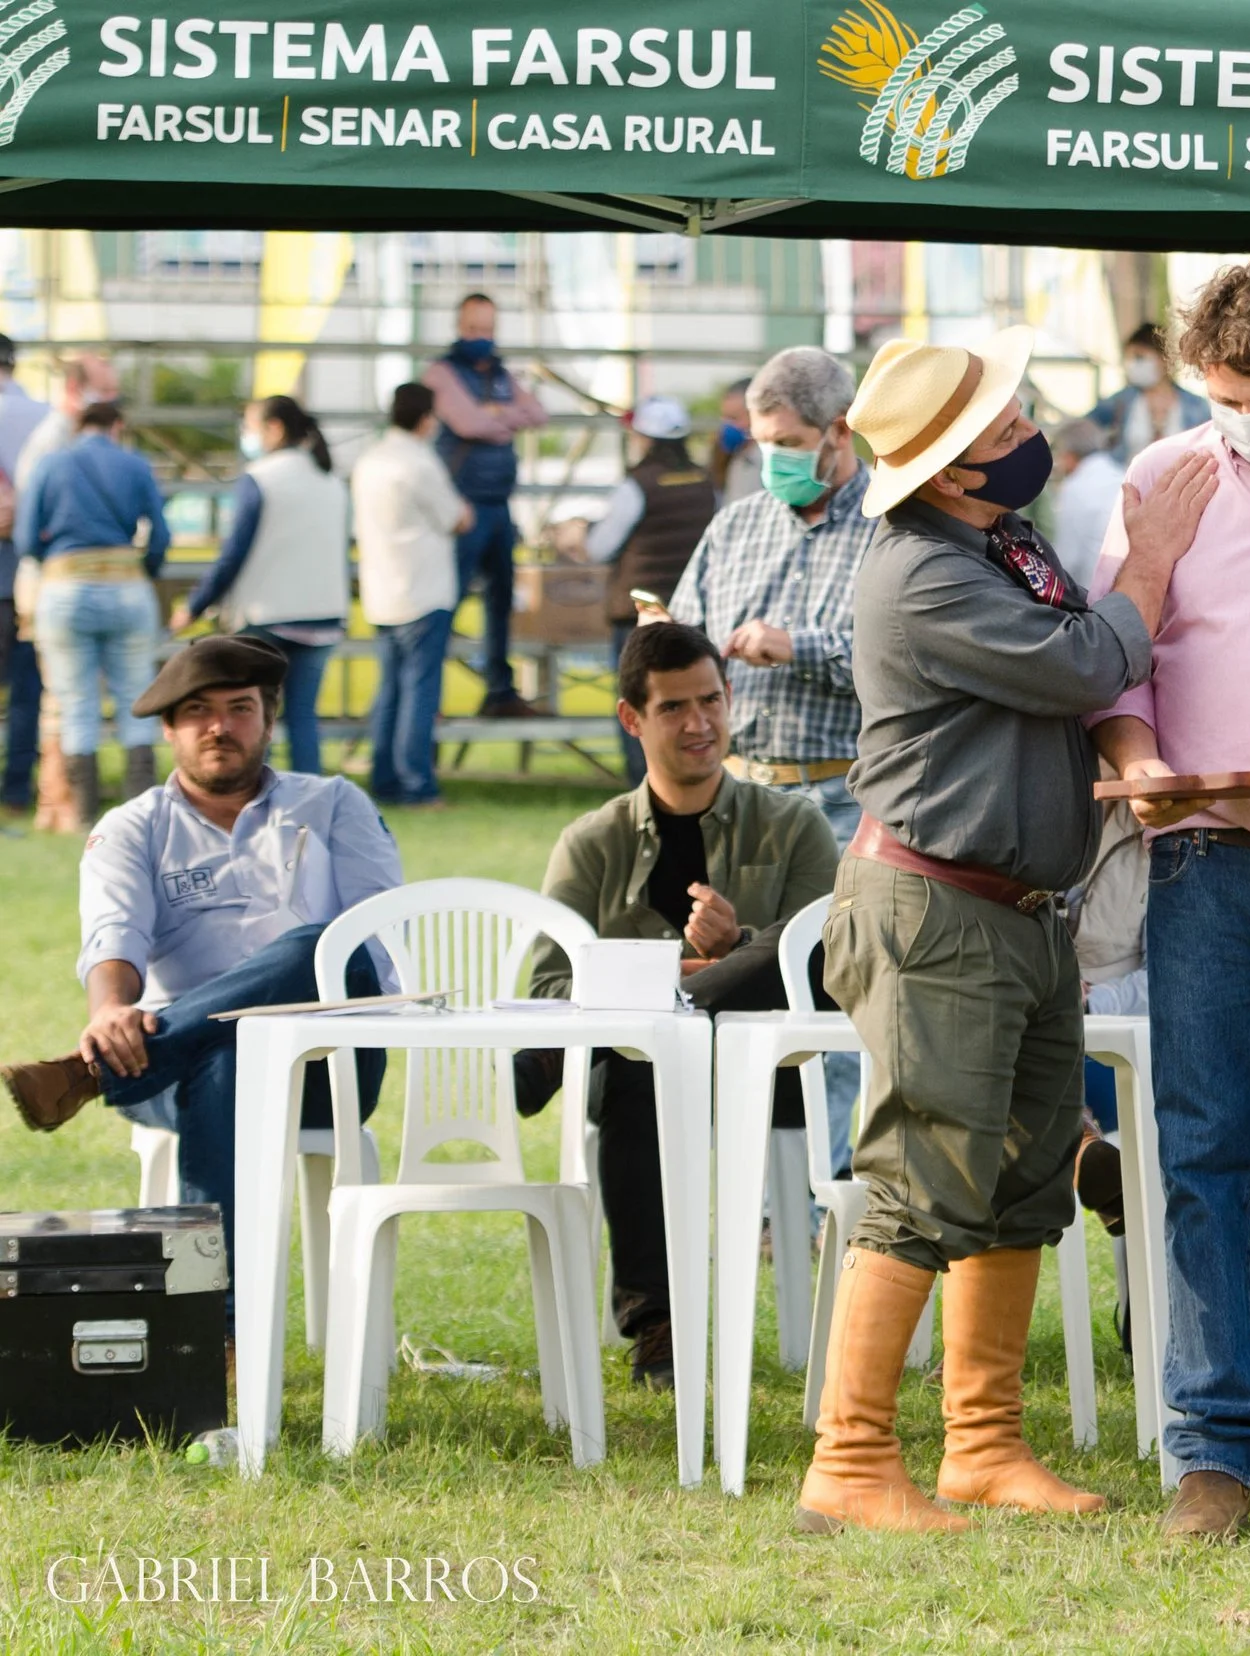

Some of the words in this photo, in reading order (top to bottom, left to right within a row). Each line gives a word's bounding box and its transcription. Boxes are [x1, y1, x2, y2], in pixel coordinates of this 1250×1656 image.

[97, 15, 450, 83] SISTEMA
[471, 27, 777, 91] FARSUL
[96, 102, 274, 145] FARSUL
[298, 106, 463, 149] SENAR
[486, 112, 613, 152] CASA
[623, 115, 777, 157] RURAL
[1046, 128, 1220, 172] FARSUL
[165, 871, 210, 896] T&B
